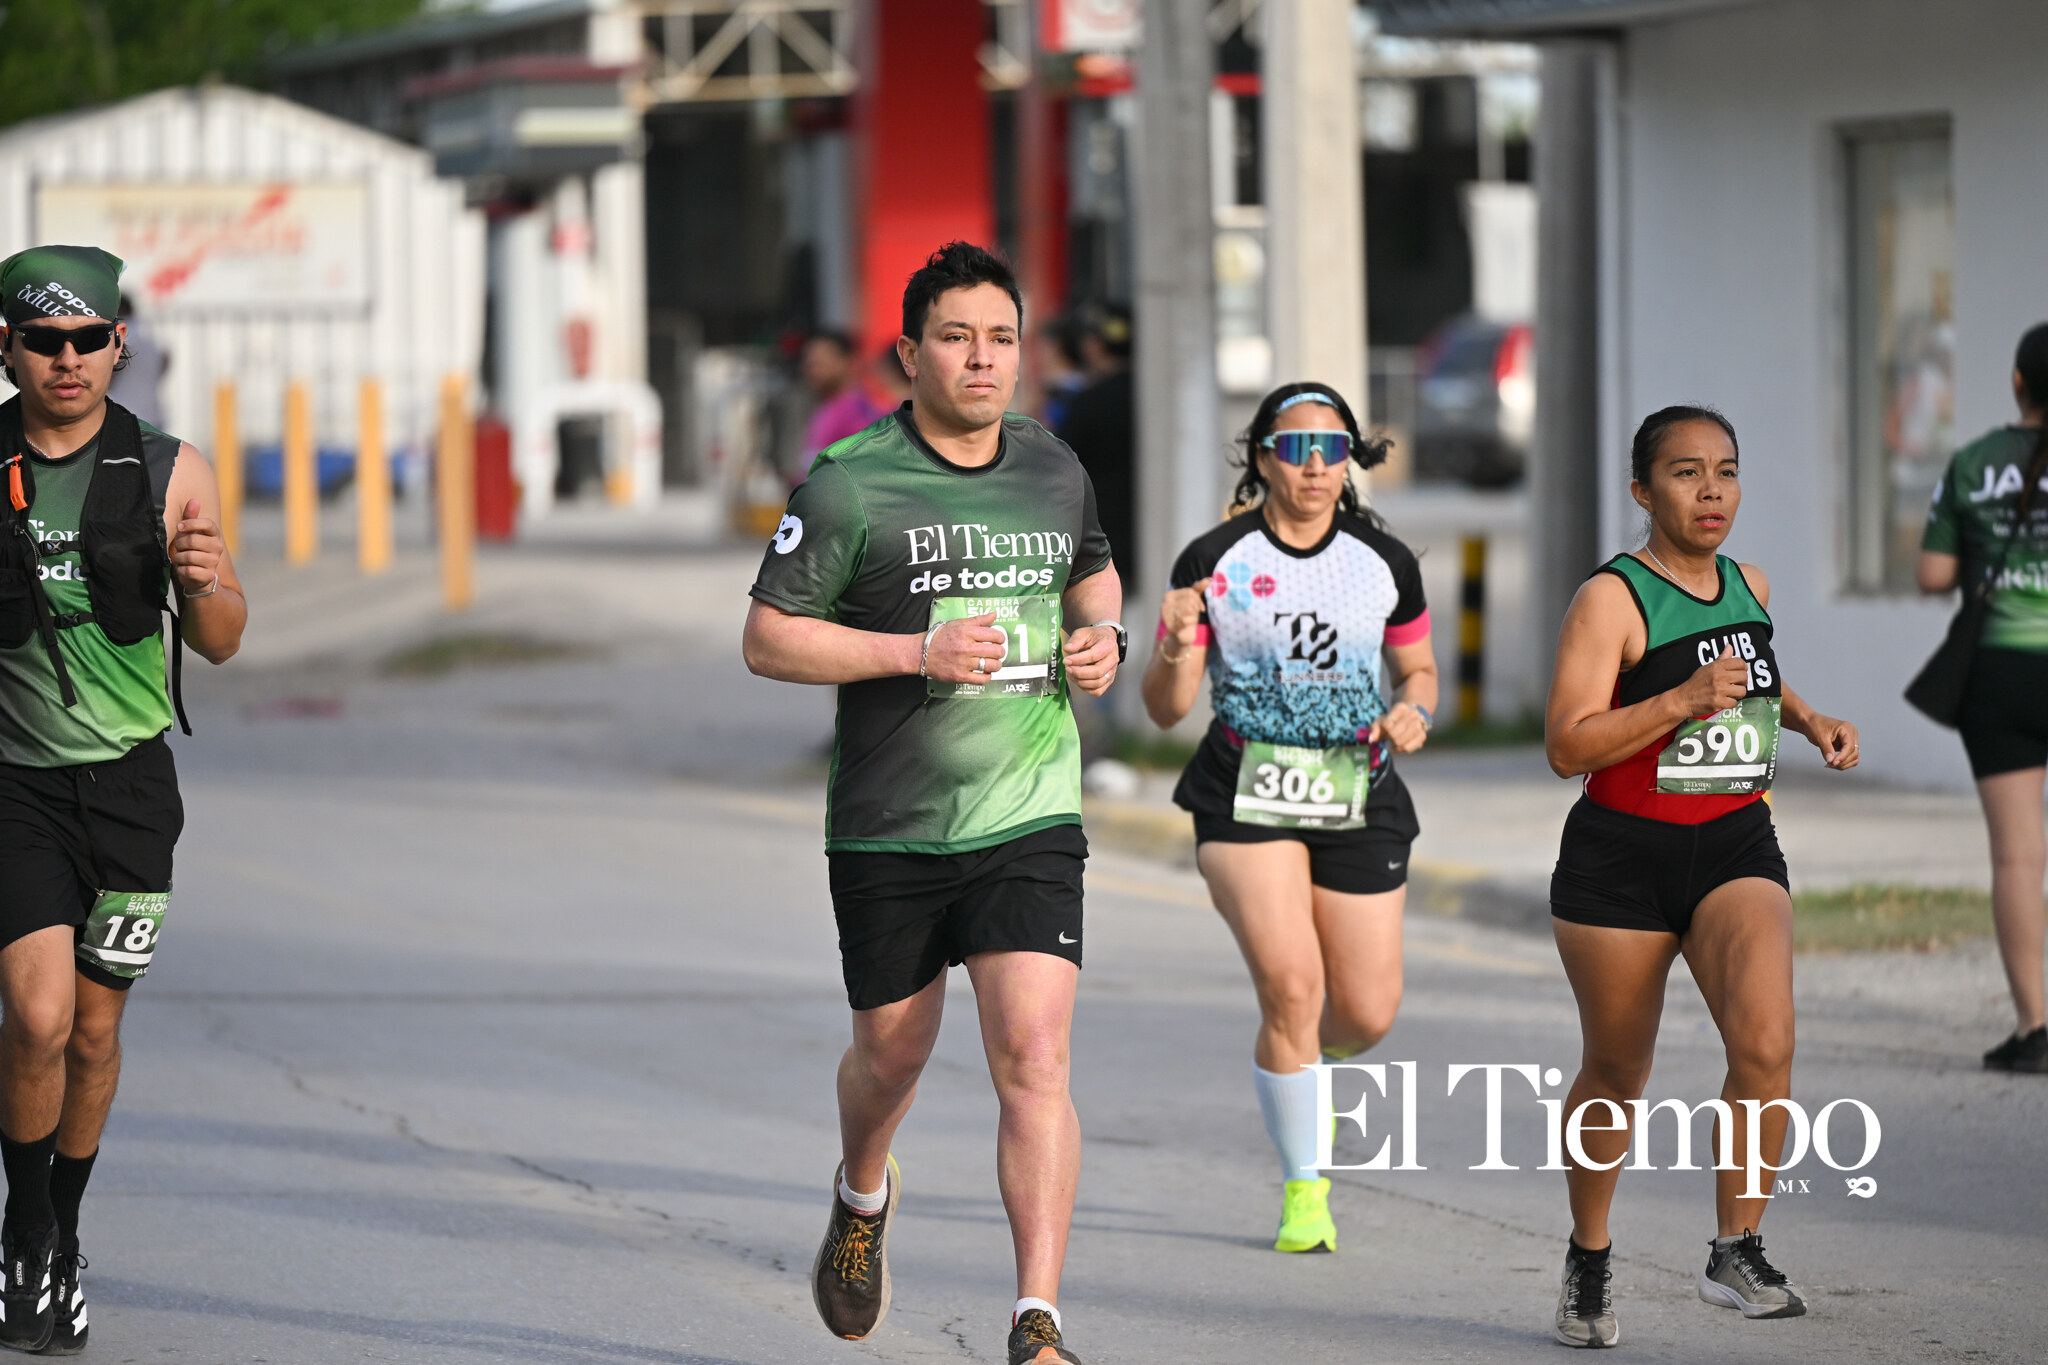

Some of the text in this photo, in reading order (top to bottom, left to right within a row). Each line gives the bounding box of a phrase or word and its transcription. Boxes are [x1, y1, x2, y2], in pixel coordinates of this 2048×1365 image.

[46, 282, 101, 317] odos
[903, 524, 1073, 566] El Tiempo
[909, 565, 1055, 594] de todos
[967, 598, 1020, 607] CARRERA
[1049, 614, 1058, 681] MEDALLA
[1698, 632, 1757, 666] CLUB
[1677, 724, 1760, 764] 590
[1767, 718, 1780, 780] MEDALLA
[1253, 762, 1335, 804] 306
[103, 915, 160, 952] 18
